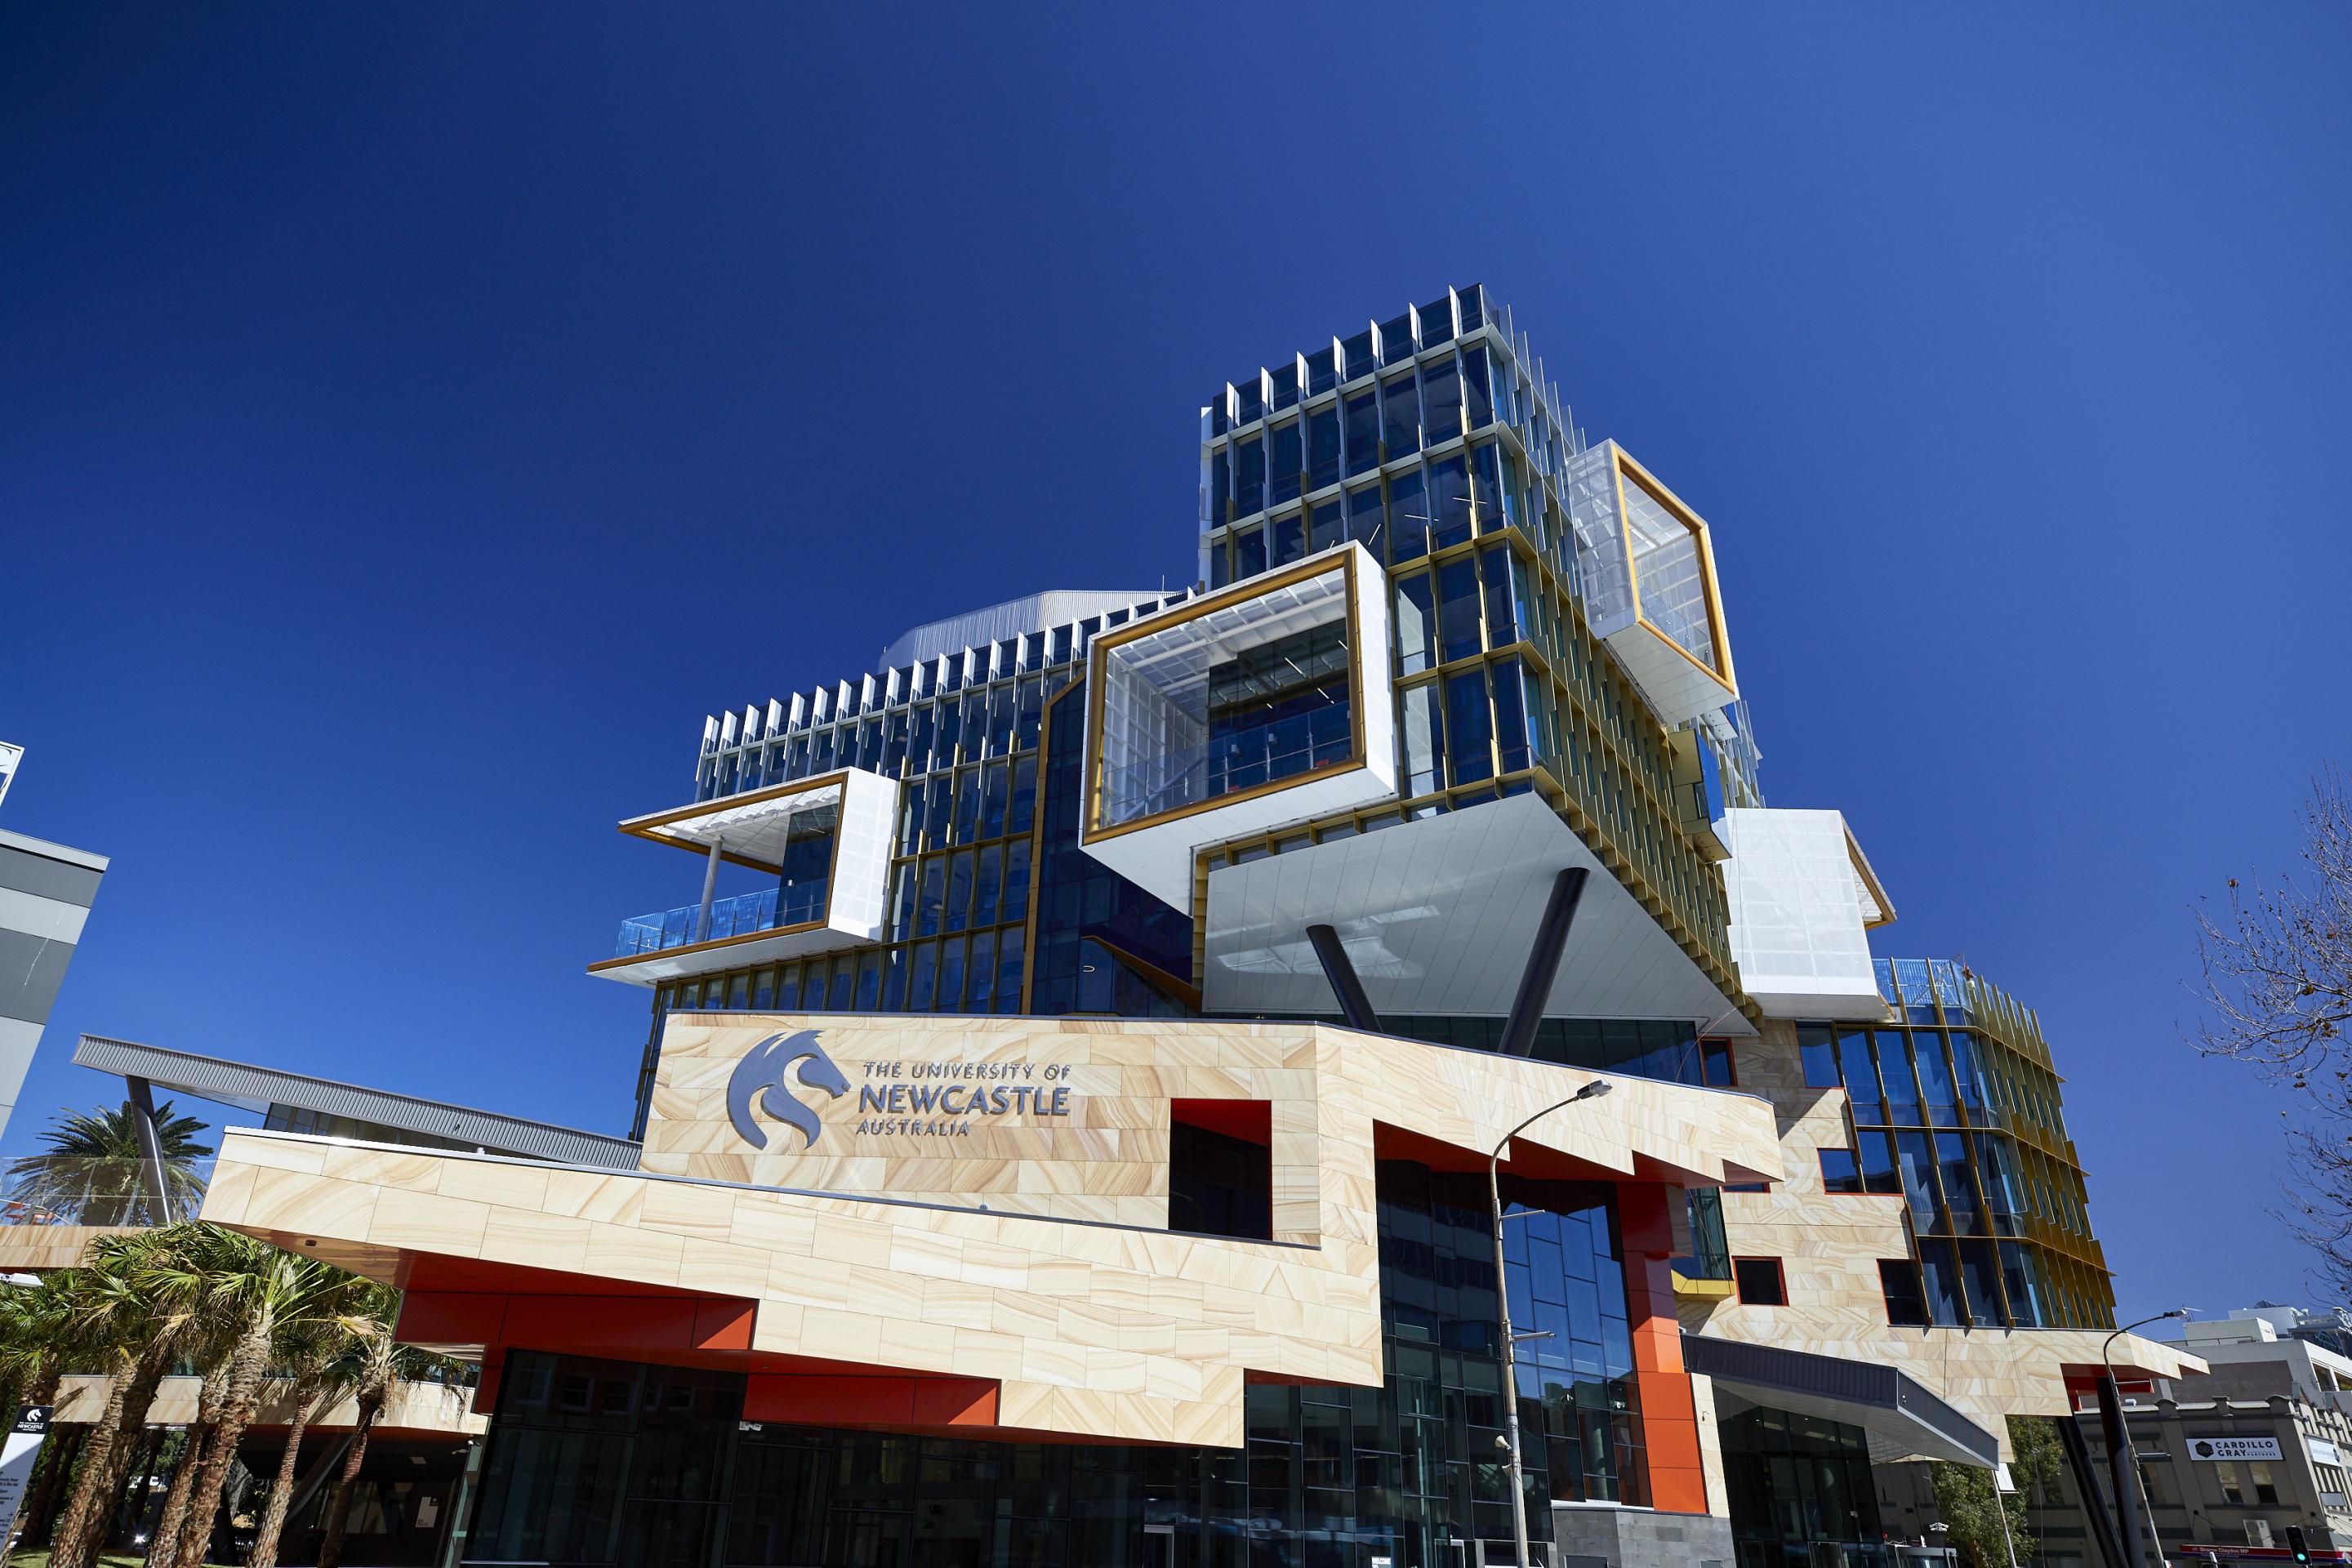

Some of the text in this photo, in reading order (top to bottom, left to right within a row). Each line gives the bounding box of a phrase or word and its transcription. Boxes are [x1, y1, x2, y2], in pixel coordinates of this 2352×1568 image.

[863, 1061, 1071, 1080] THE UNIVERSITY OF
[858, 1084, 1071, 1116] NEWCASTLE
[856, 1118, 970, 1137] AUSTRALIA
